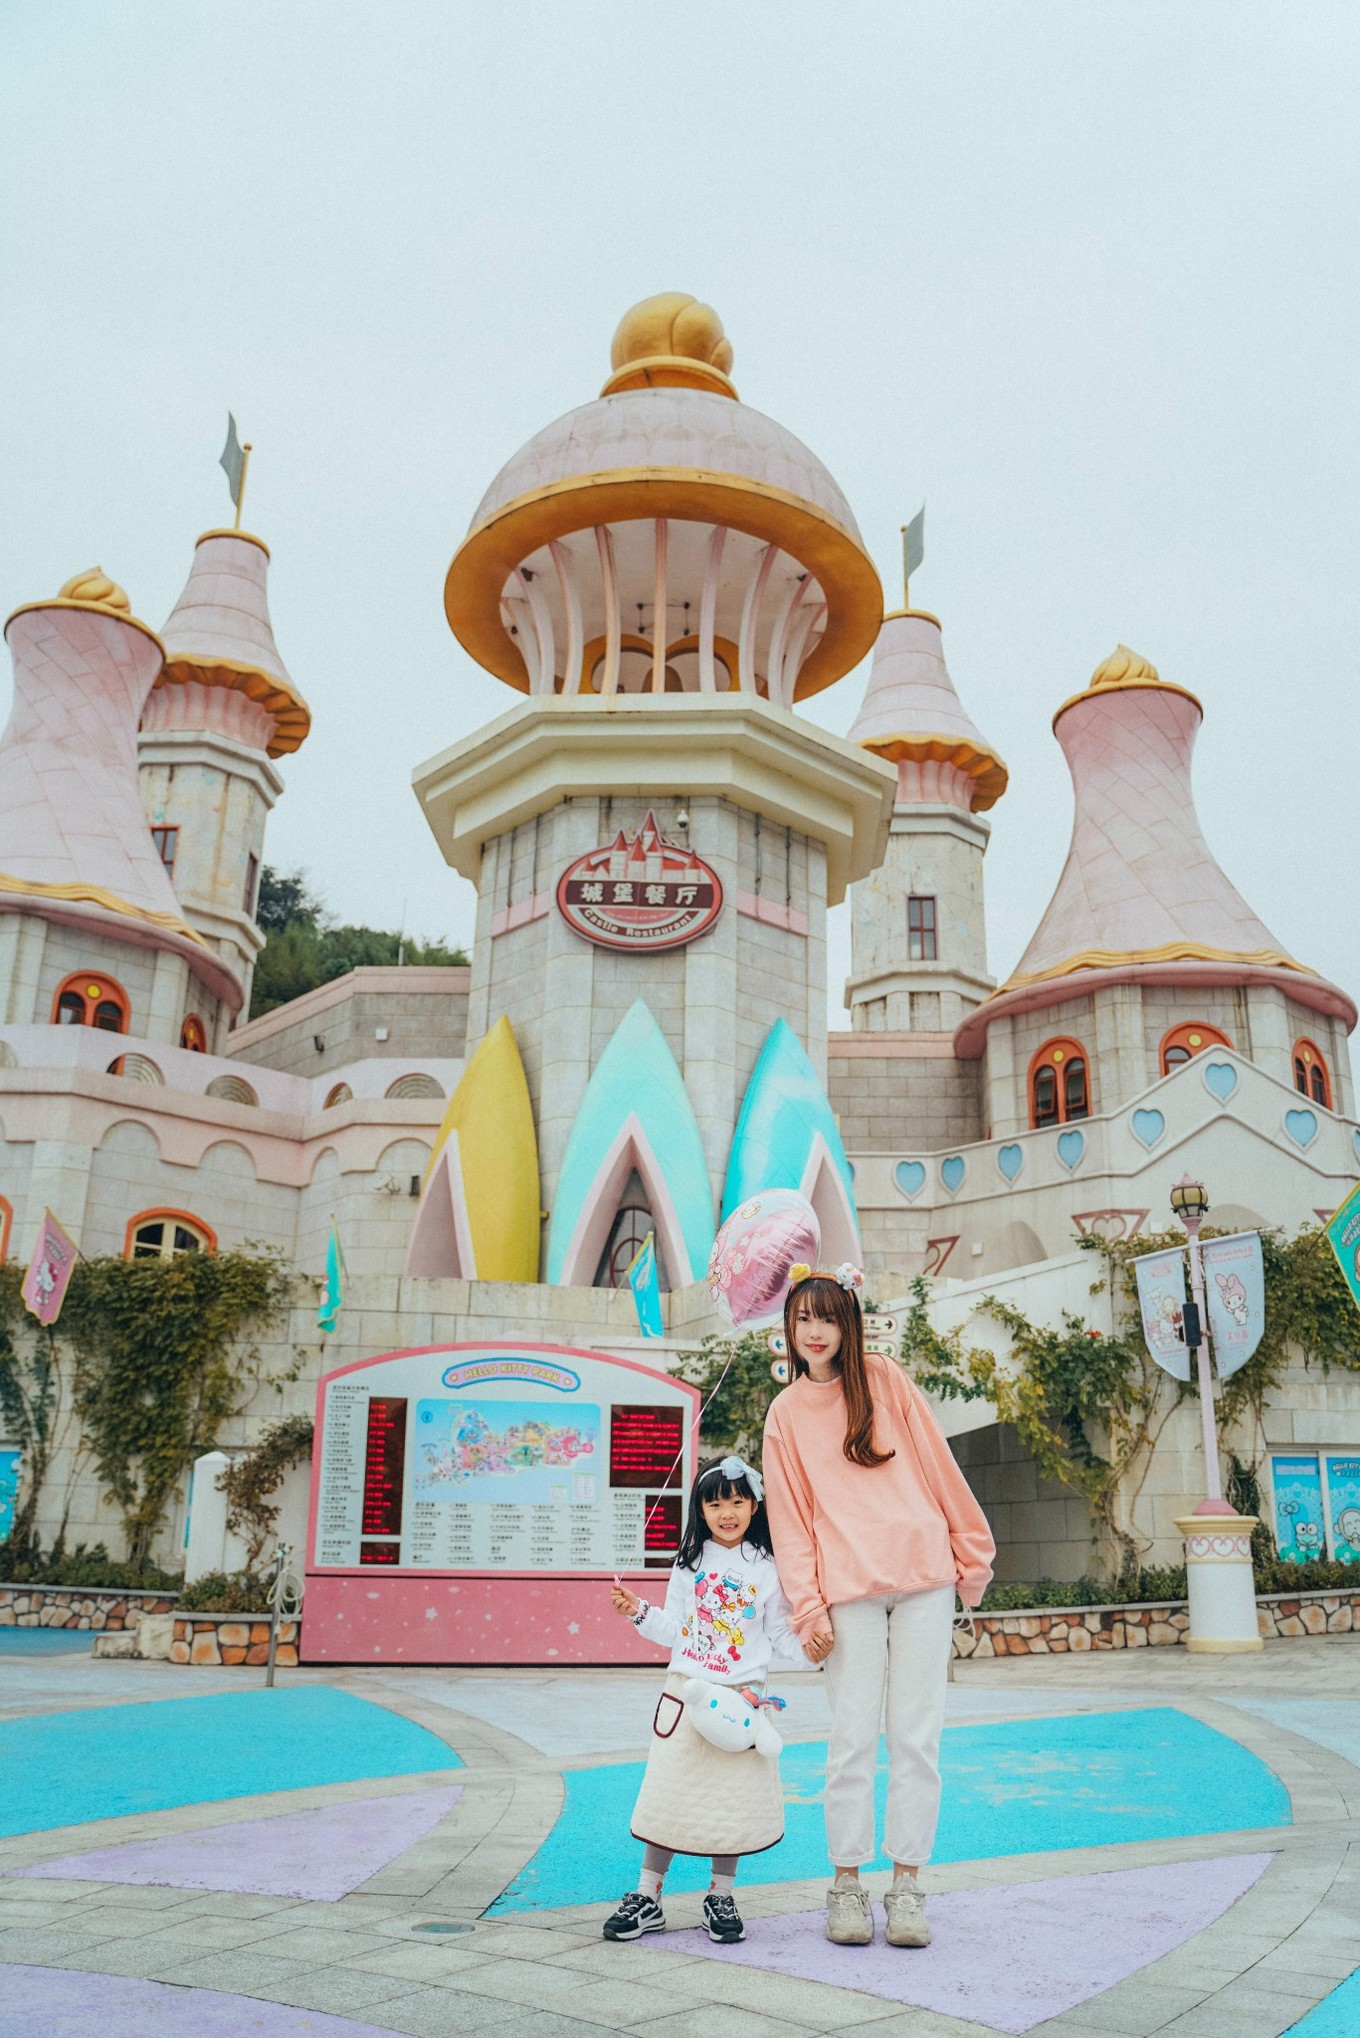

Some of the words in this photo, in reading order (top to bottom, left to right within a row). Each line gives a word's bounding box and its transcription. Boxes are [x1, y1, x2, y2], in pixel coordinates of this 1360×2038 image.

[581, 882, 698, 905] 城堡餐厅
[584, 909, 618, 932] Castle
[626, 914, 692, 936] Restaurant
[465, 1365, 497, 1379] HELLO
[500, 1363, 530, 1373] KITTY
[531, 1366, 559, 1382] PARK
[703, 1660, 732, 1675] Family
